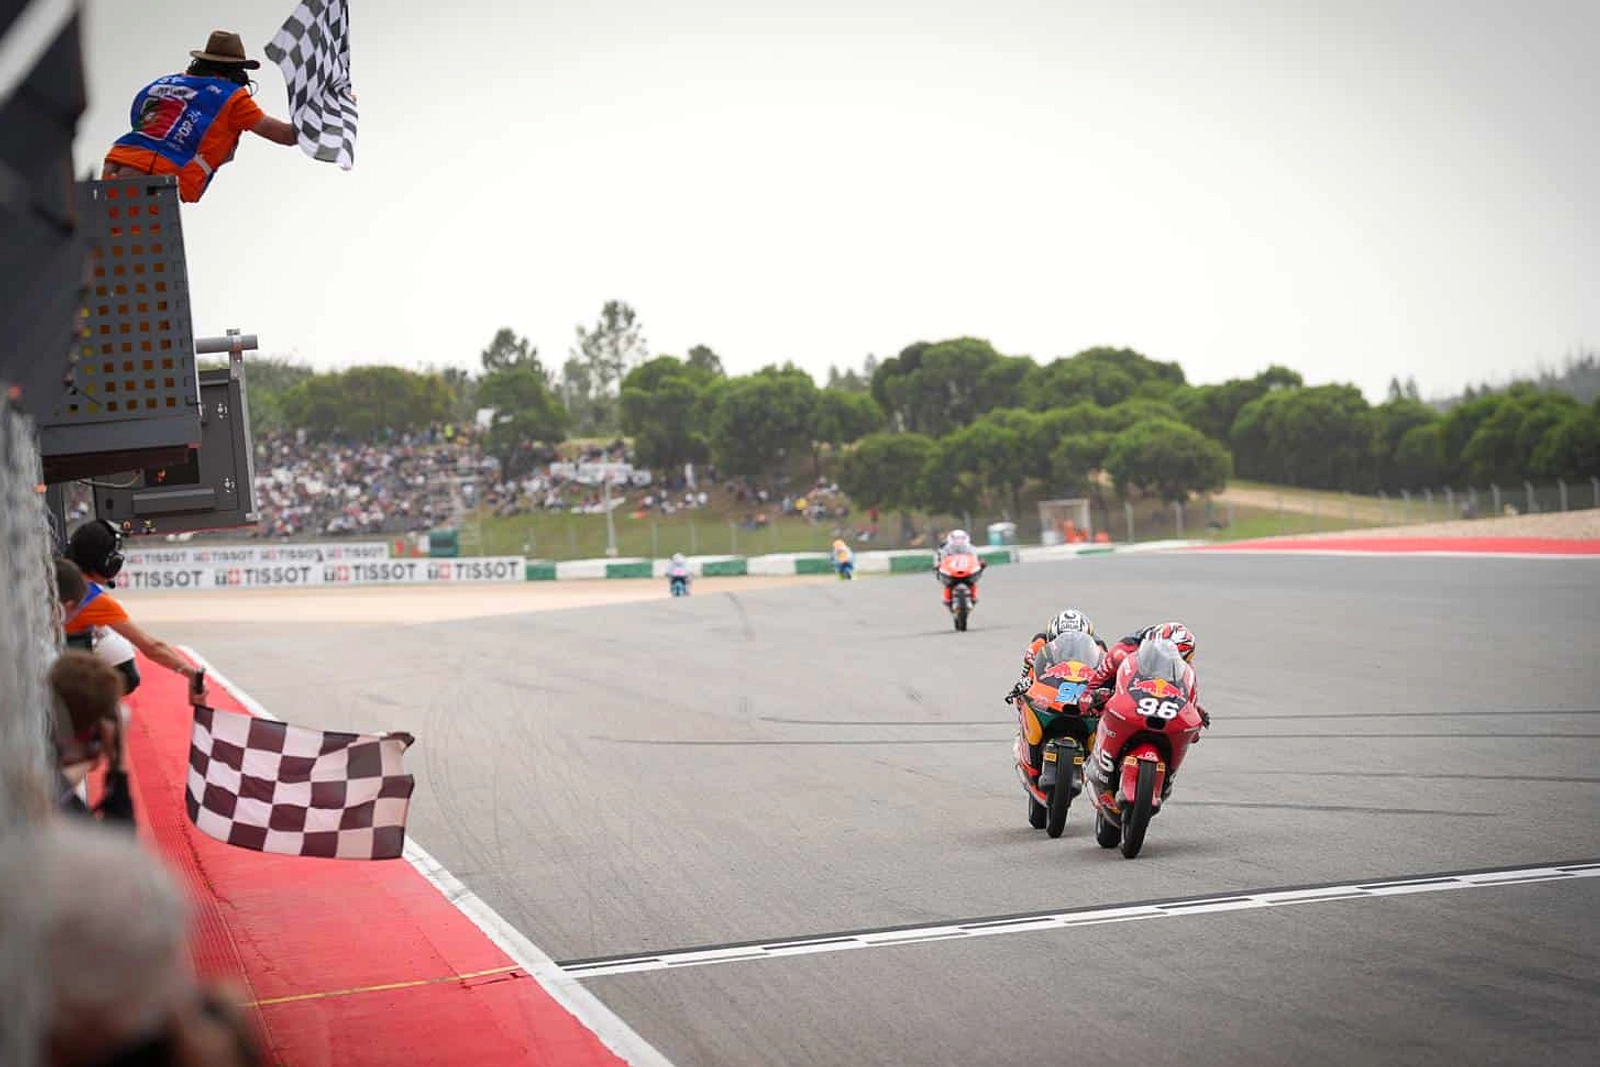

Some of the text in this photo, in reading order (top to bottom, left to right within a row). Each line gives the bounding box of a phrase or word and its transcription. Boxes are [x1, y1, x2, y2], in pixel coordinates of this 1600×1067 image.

[145, 552, 187, 564] TISSOT
[212, 550, 254, 562] TISSOT
[344, 547, 384, 558] TISSOT
[244, 566, 311, 585] TISSOT
[352, 563, 416, 581] TISSOT
[455, 561, 519, 579] TISSOT
[132, 570, 203, 589] TISSOT
[1137, 698, 1179, 719] 96
